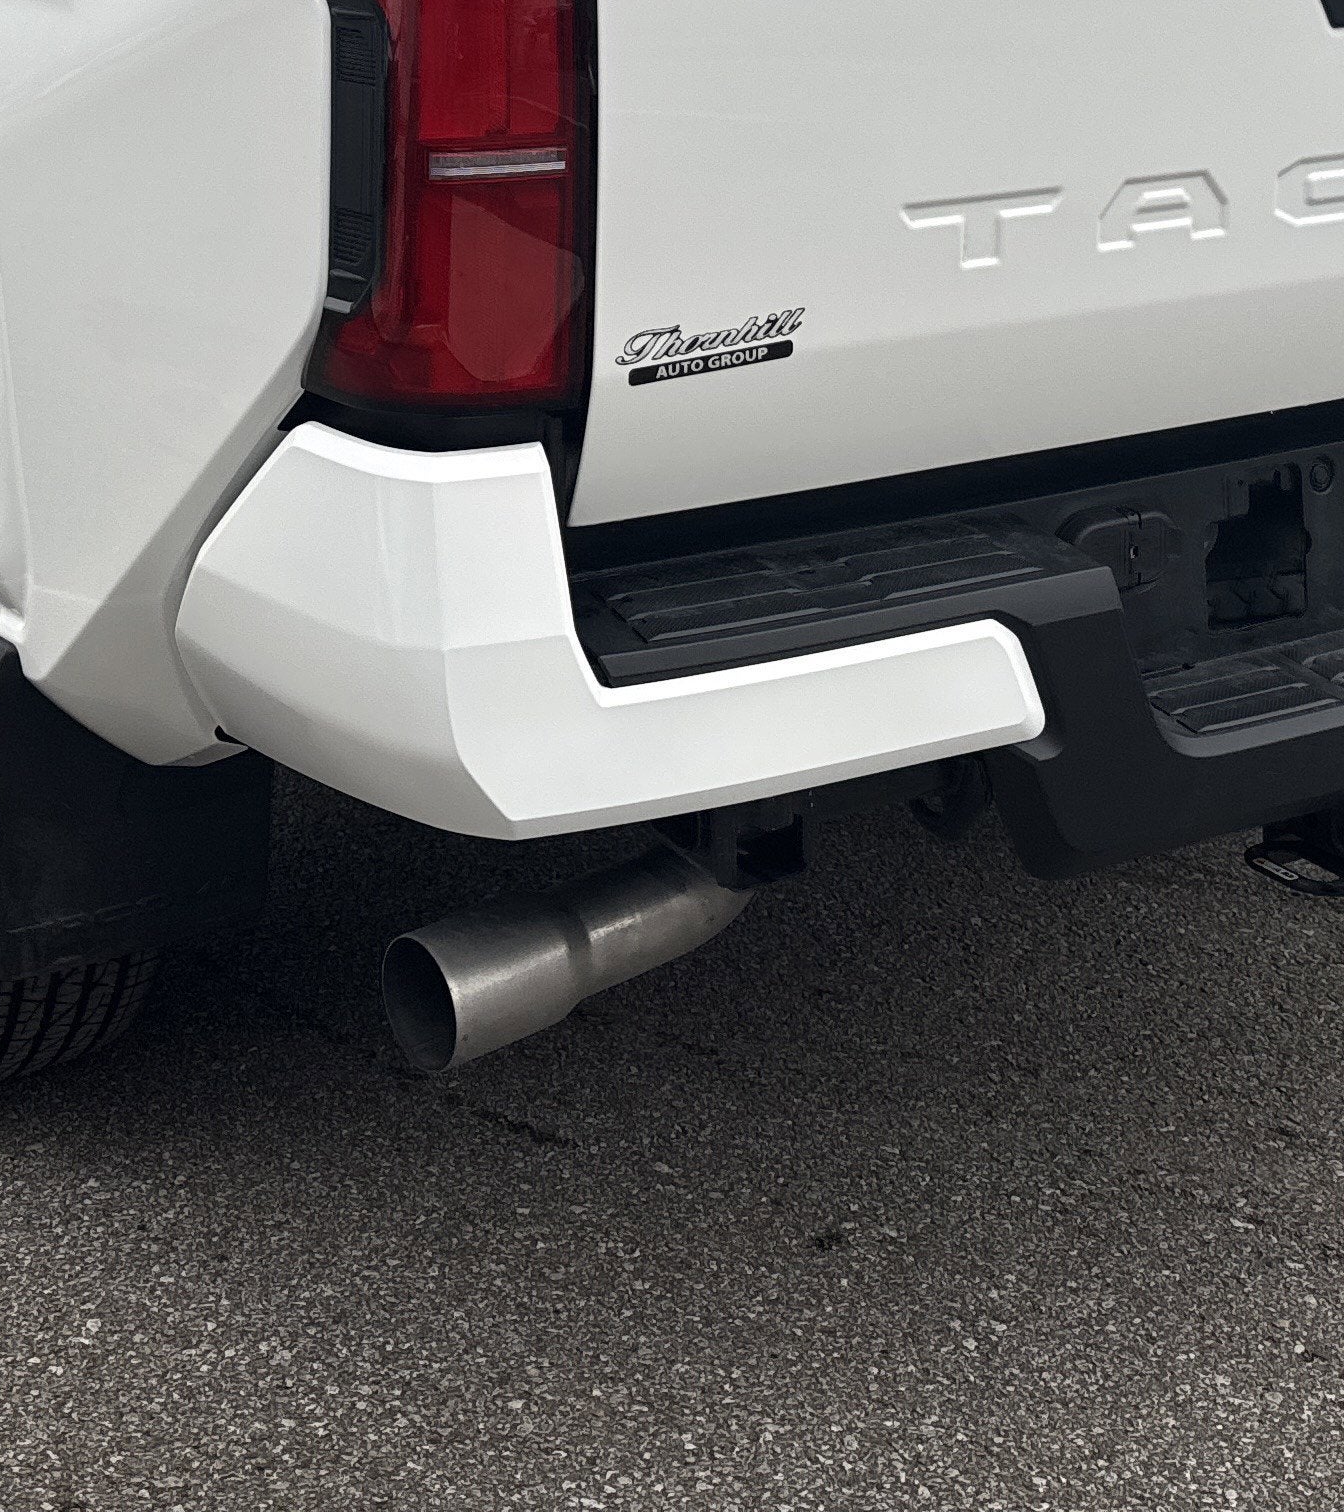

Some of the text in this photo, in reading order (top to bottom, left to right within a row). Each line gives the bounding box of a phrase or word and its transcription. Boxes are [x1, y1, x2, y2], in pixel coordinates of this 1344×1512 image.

[615, 306, 806, 366] Thornhill
[656, 347, 769, 380] AUTO GROUP
